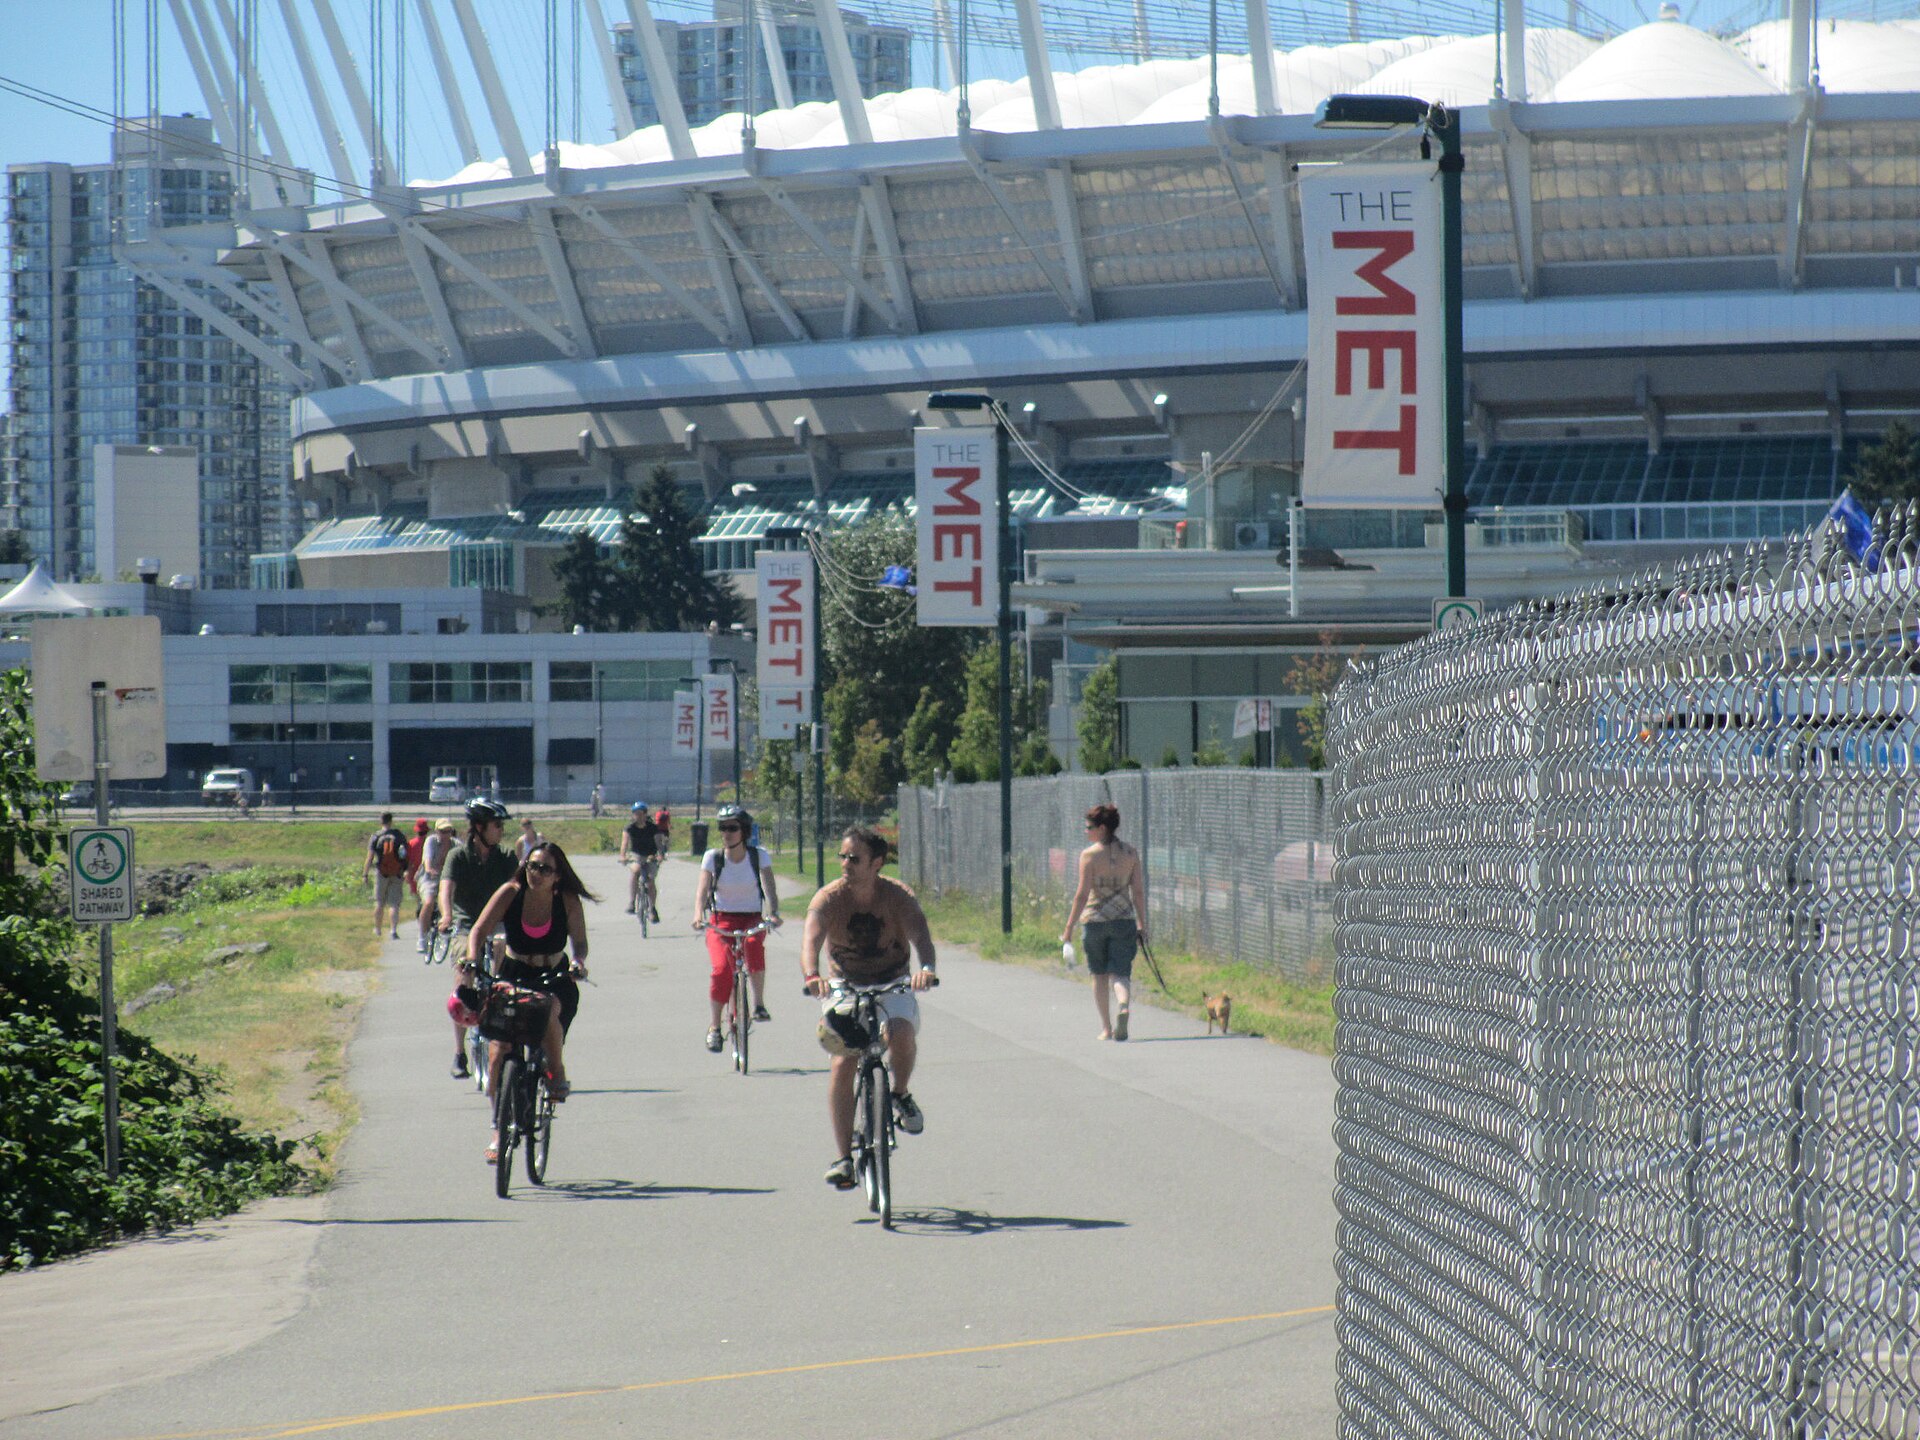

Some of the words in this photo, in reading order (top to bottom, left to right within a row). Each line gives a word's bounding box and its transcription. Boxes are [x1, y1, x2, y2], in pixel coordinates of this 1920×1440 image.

[1330, 190, 1413, 222] THE
[1332, 231, 1416, 475] MET
[932, 443, 980, 463] THE
[933, 467, 982, 606] MET
[768, 562, 802, 576] THE
[768, 579, 803, 676] MET
[677, 704, 695, 751] MET
[709, 689, 729, 742] MET
[79, 901, 125, 914] PATHWAY
[80, 887, 123, 900] SHARED
